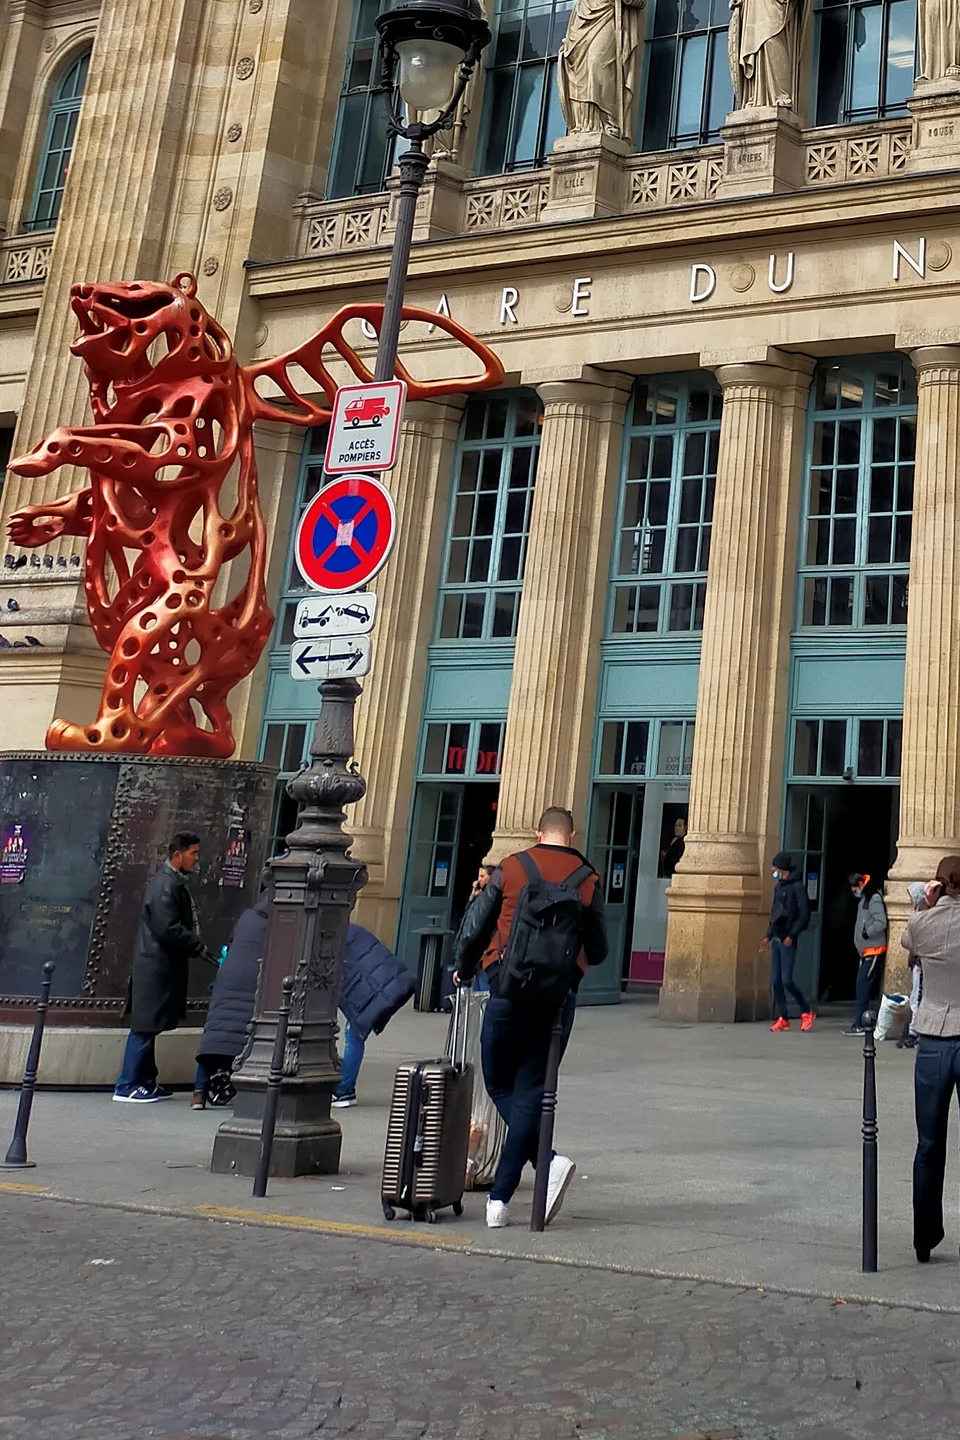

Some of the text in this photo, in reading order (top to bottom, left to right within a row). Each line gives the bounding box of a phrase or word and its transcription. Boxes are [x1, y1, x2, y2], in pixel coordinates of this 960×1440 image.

[689, 252, 795, 303] DU
[348, 437, 376, 451] ACCÈS
[338, 450, 382, 464] POMPIERS
